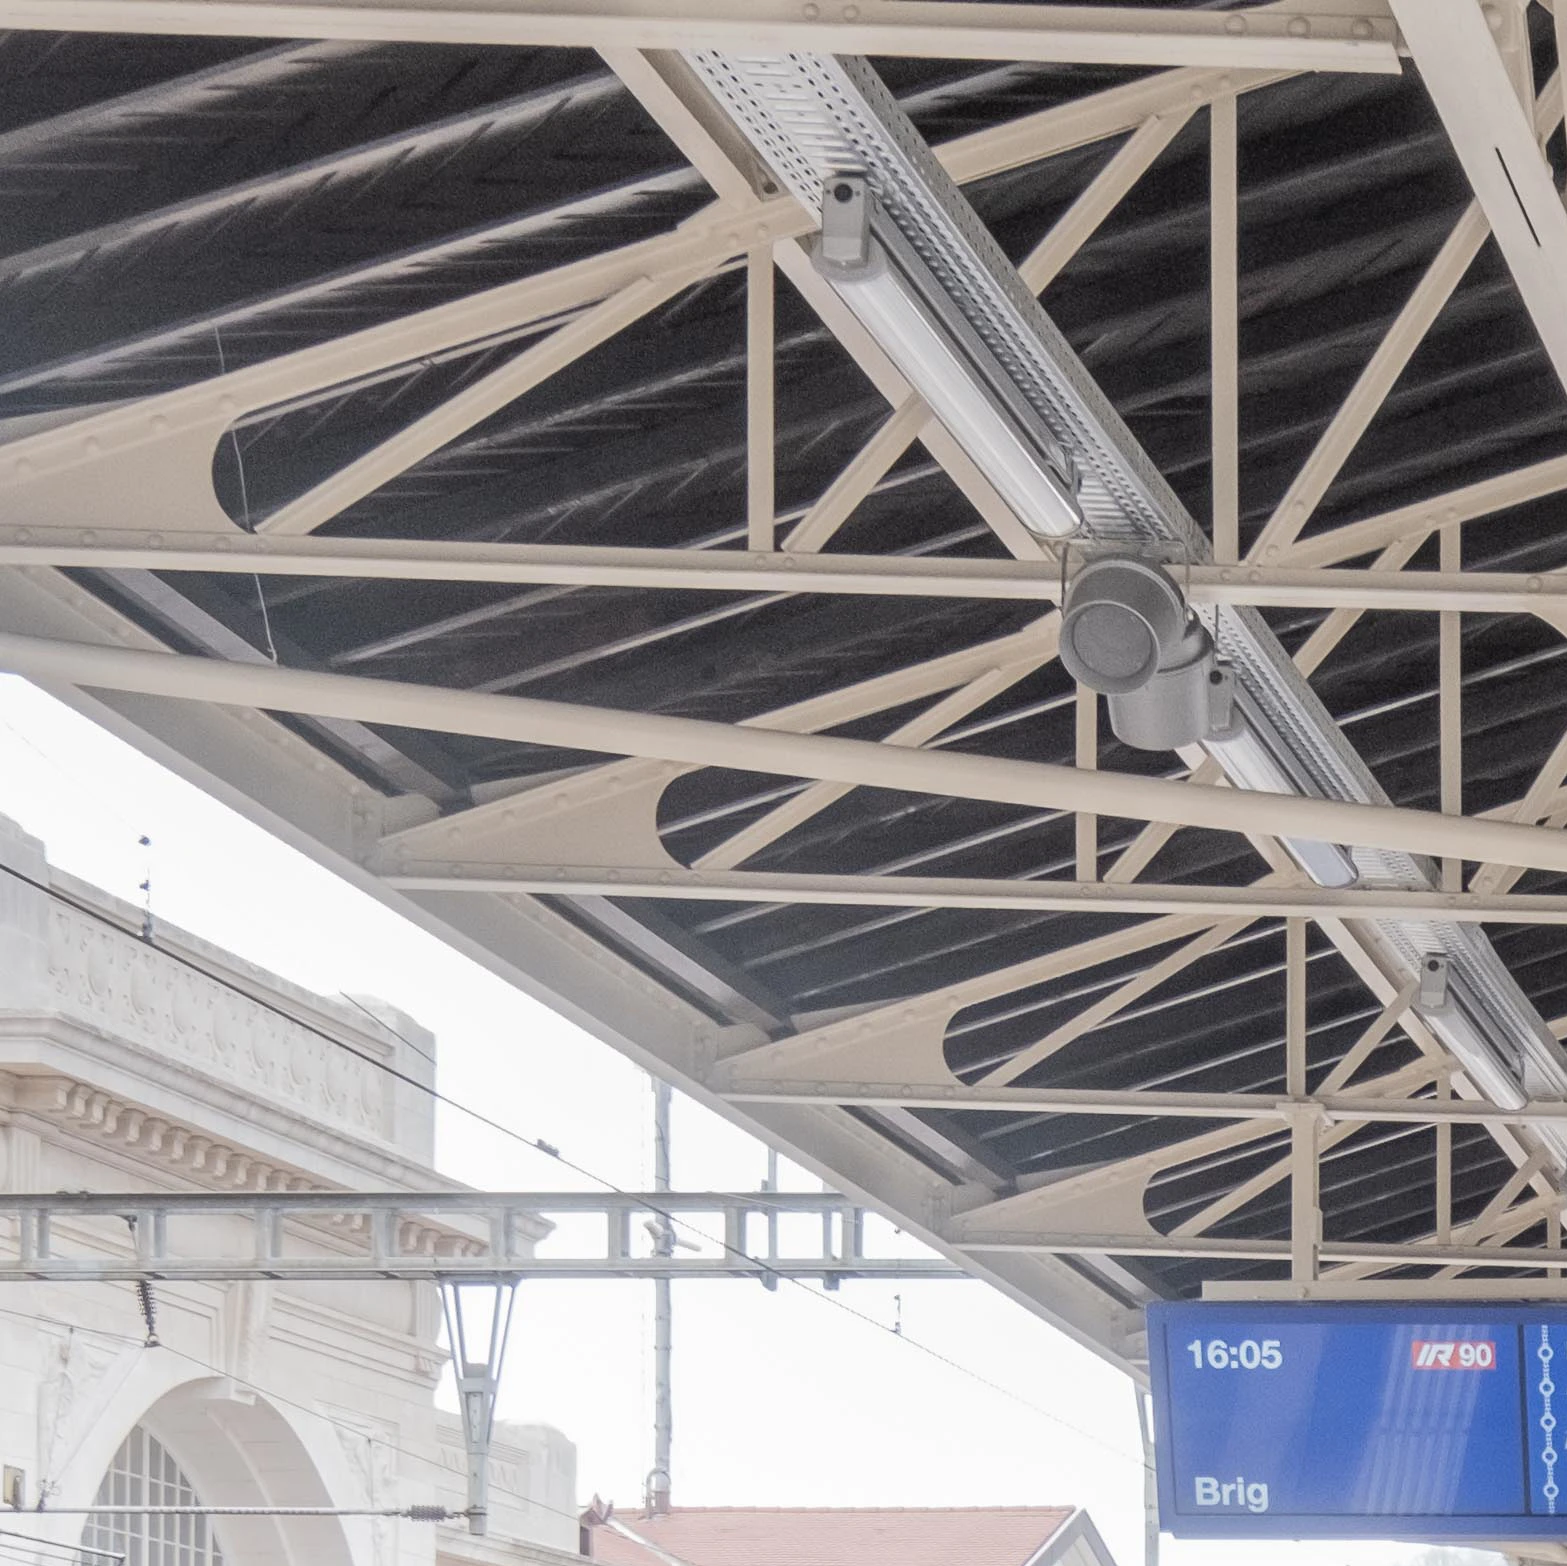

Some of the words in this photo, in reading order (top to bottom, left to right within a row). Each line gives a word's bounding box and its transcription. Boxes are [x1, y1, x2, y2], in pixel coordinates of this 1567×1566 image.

[1187, 1340, 1283, 1369] 16:05
[1416, 1343, 1455, 1367] IR
[1460, 1343, 1492, 1367] 90
[1195, 1477, 1268, 1513] Brig
